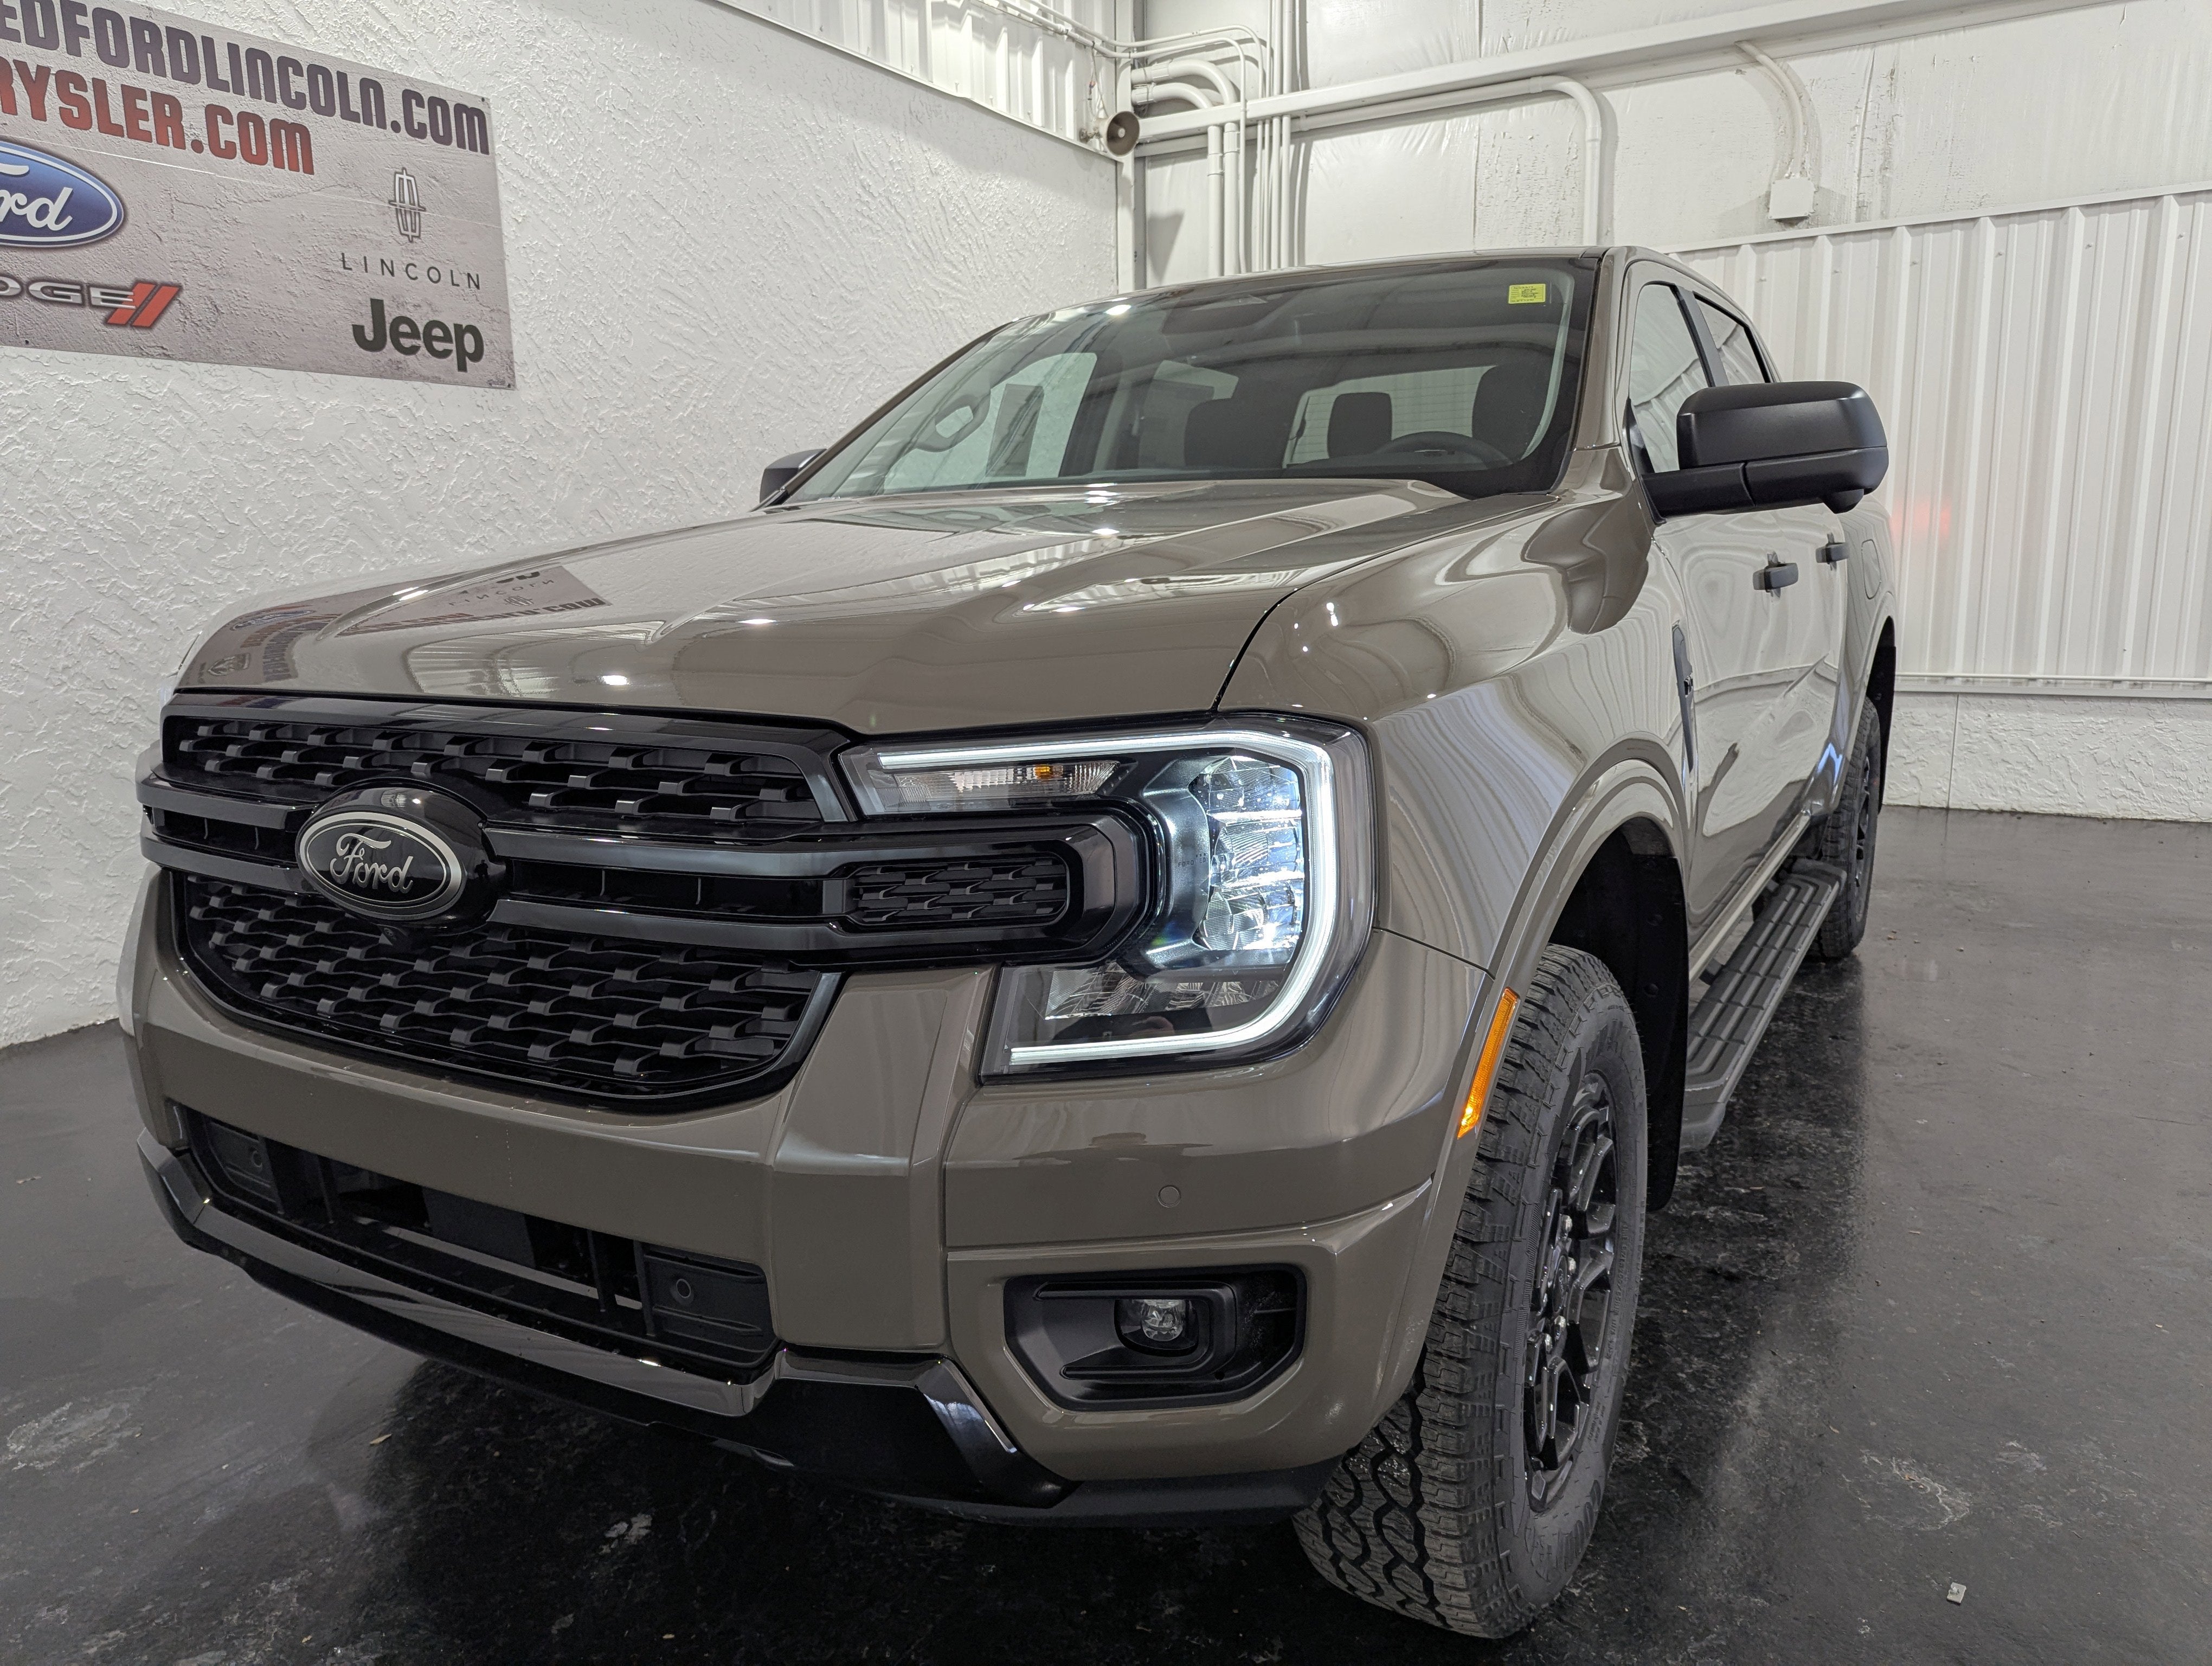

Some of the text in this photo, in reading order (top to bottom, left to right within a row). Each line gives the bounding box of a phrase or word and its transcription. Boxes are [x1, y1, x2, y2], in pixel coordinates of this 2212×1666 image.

[0, 163, 73, 231] rd
[342, 253, 480, 290] LINCOLN
[352, 298, 484, 373] Jeep
[330, 832, 414, 894] Ford
